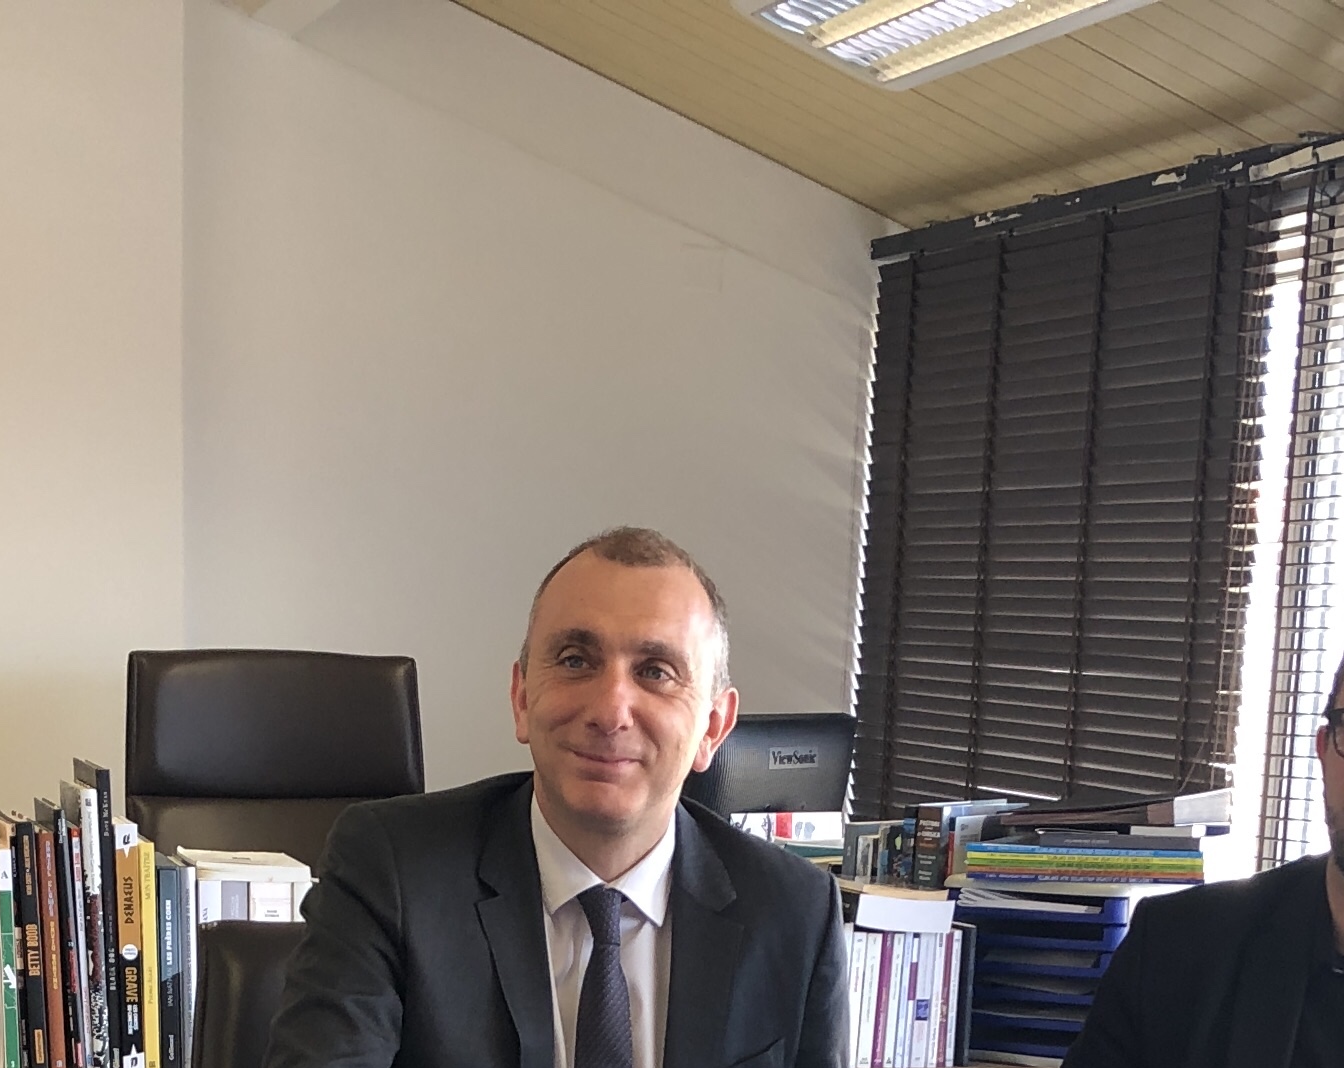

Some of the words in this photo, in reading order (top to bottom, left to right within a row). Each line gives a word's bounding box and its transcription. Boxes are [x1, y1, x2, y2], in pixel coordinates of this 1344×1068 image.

[772, 750, 816, 765] ViewSonic
[25, 924, 38, 946] BOOB
[164, 922, 172, 950] FRÈRES
[27, 949, 40, 976] BETTY
[109, 967, 117, 990] BLACK
[125, 967, 138, 1002] GRAVE
